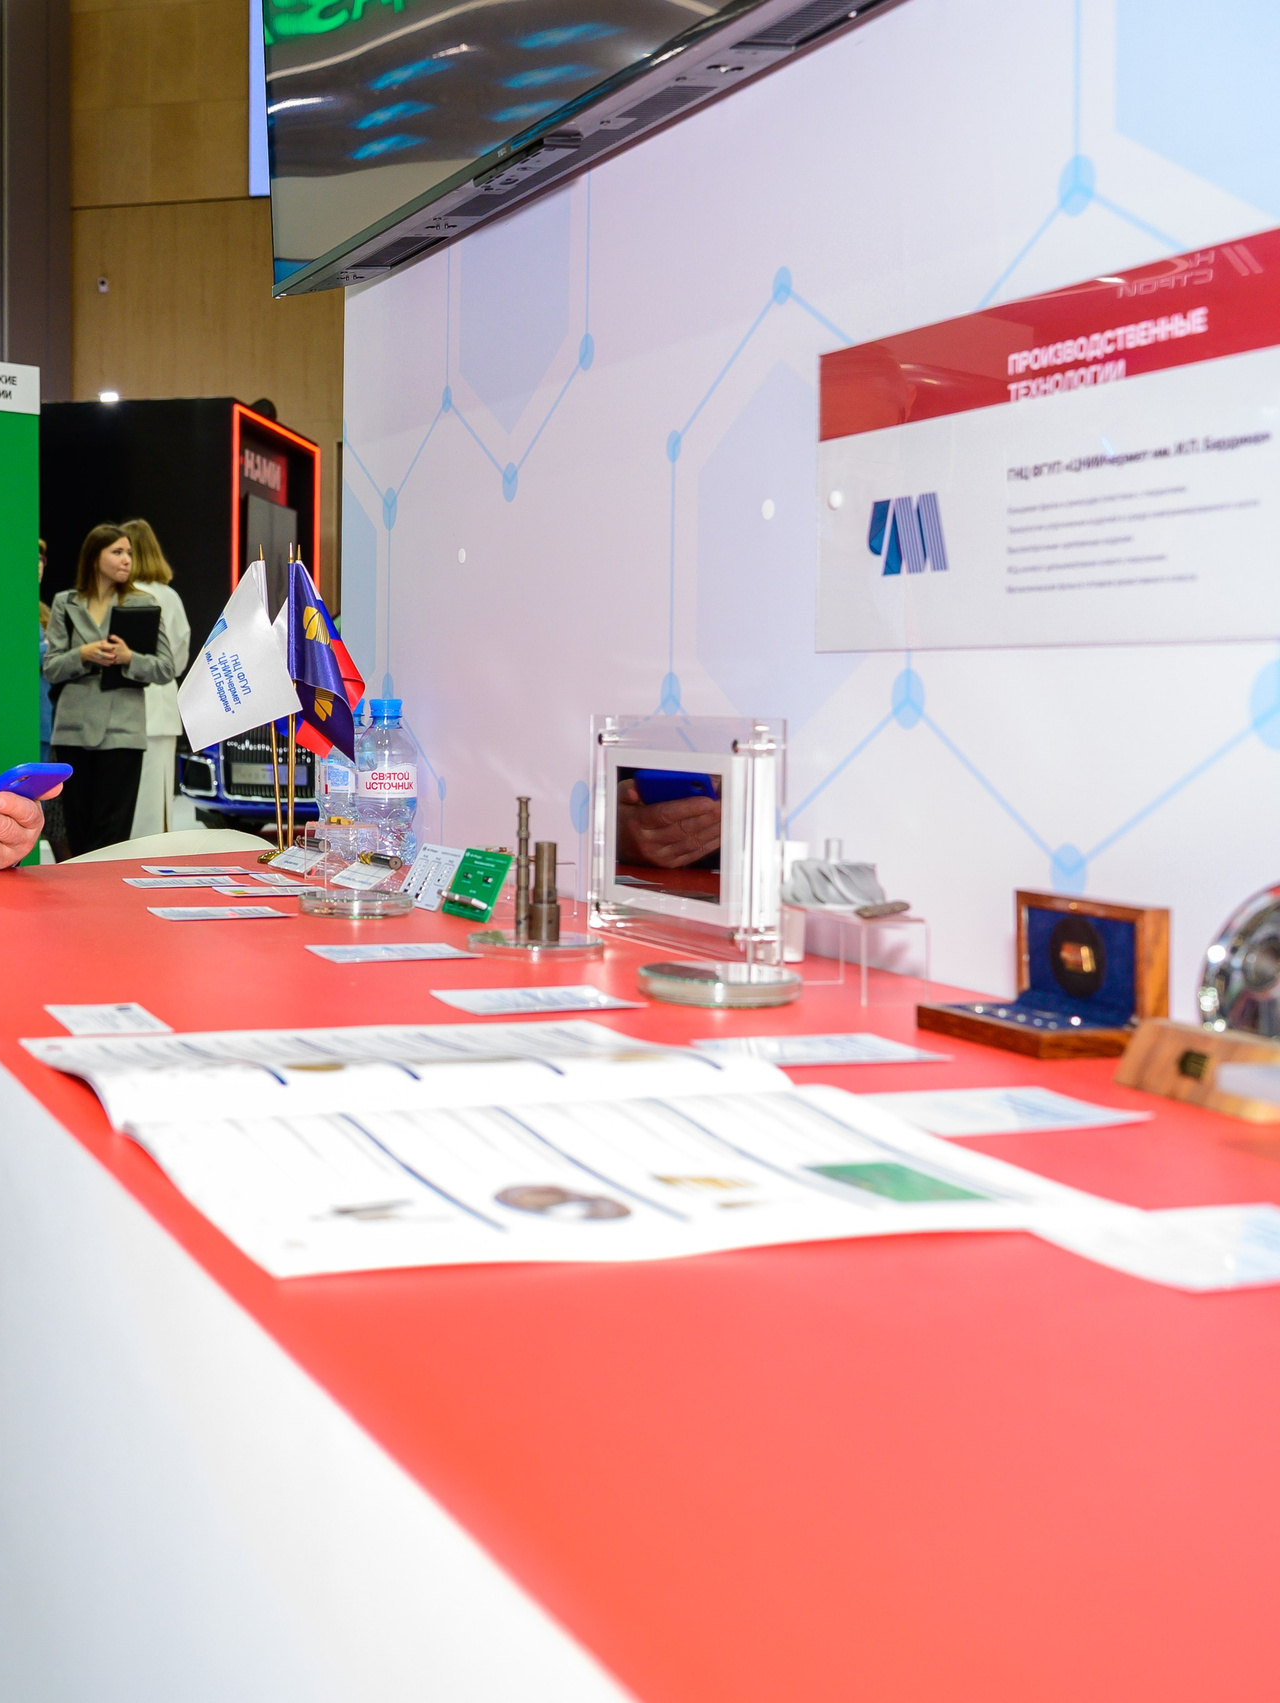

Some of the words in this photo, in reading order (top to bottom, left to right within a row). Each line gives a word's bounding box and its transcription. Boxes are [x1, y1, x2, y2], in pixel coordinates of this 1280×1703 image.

[1007, 306, 1208, 376] ПРОИЗВОДСТВЕННЫЕ
[1007, 358, 1126, 402] ТЕХНОЛОГИИ
[230, 653, 242, 672] ГНЦ
[237, 672, 252, 695] ФГУП
[365, 781, 414, 791] ИСТОЧНИК
[371, 771, 410, 781] СВЯТОЙ
